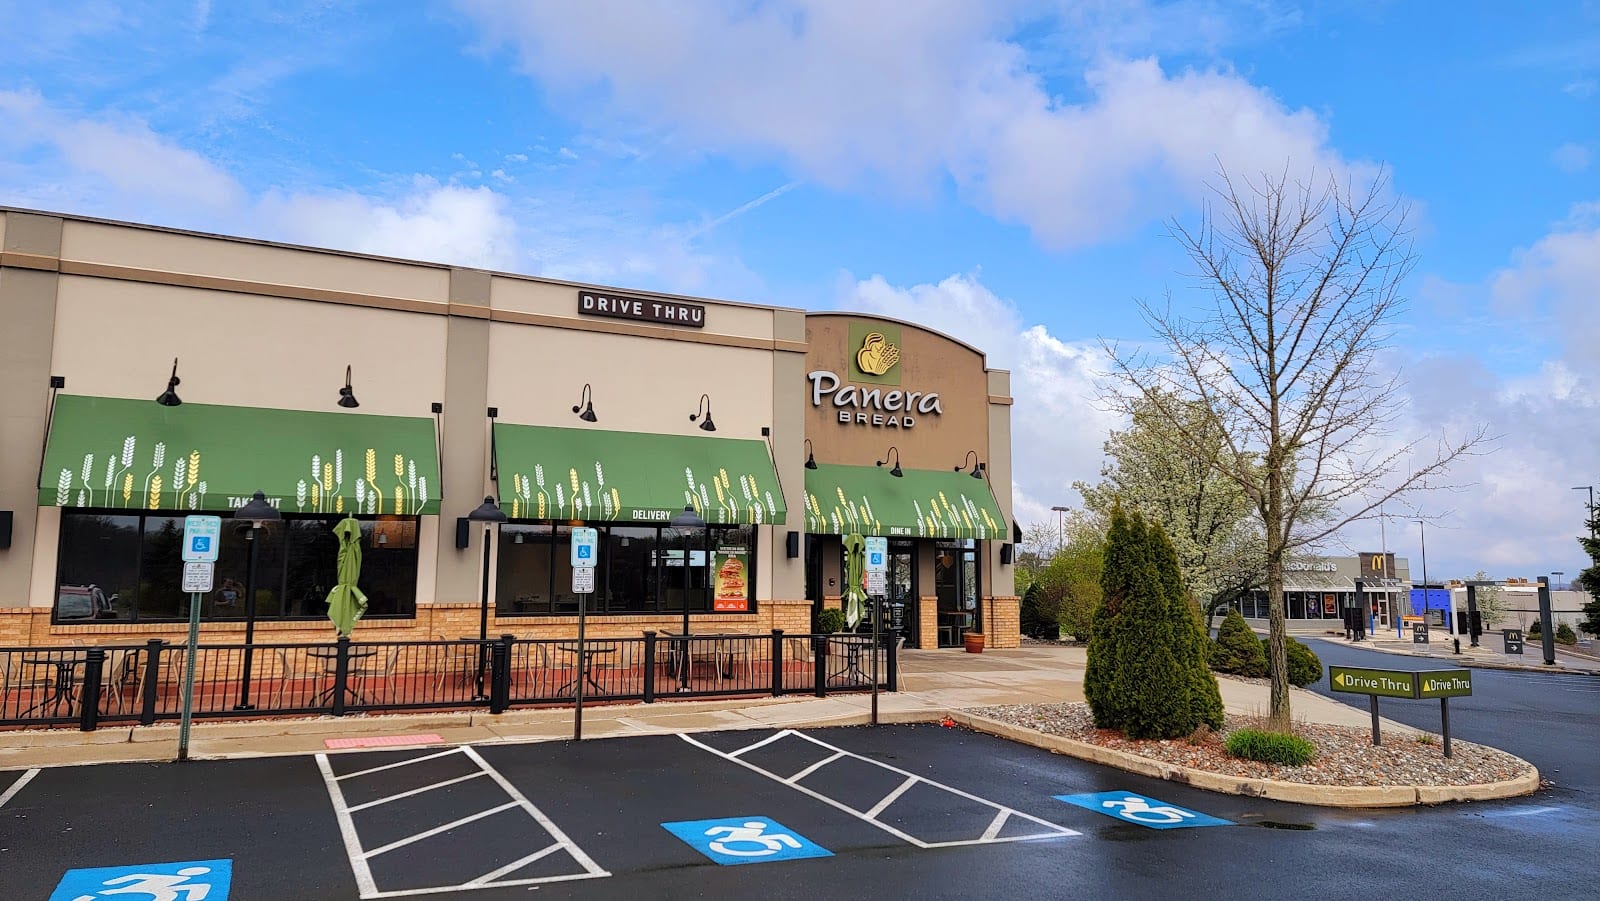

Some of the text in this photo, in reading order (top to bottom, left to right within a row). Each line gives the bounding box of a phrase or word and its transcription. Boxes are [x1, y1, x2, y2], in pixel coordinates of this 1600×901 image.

[583, 295, 702, 322] DRIVE THRU
[807, 370, 943, 414] Panera
[839, 411, 916, 428] BREAD
[632, 509, 671, 521] DELIVERY
[890, 526, 912, 536] DINE IN
[1345, 674, 1410, 692] Drive Thru
[1430, 678, 1470, 691] Drive Thru
